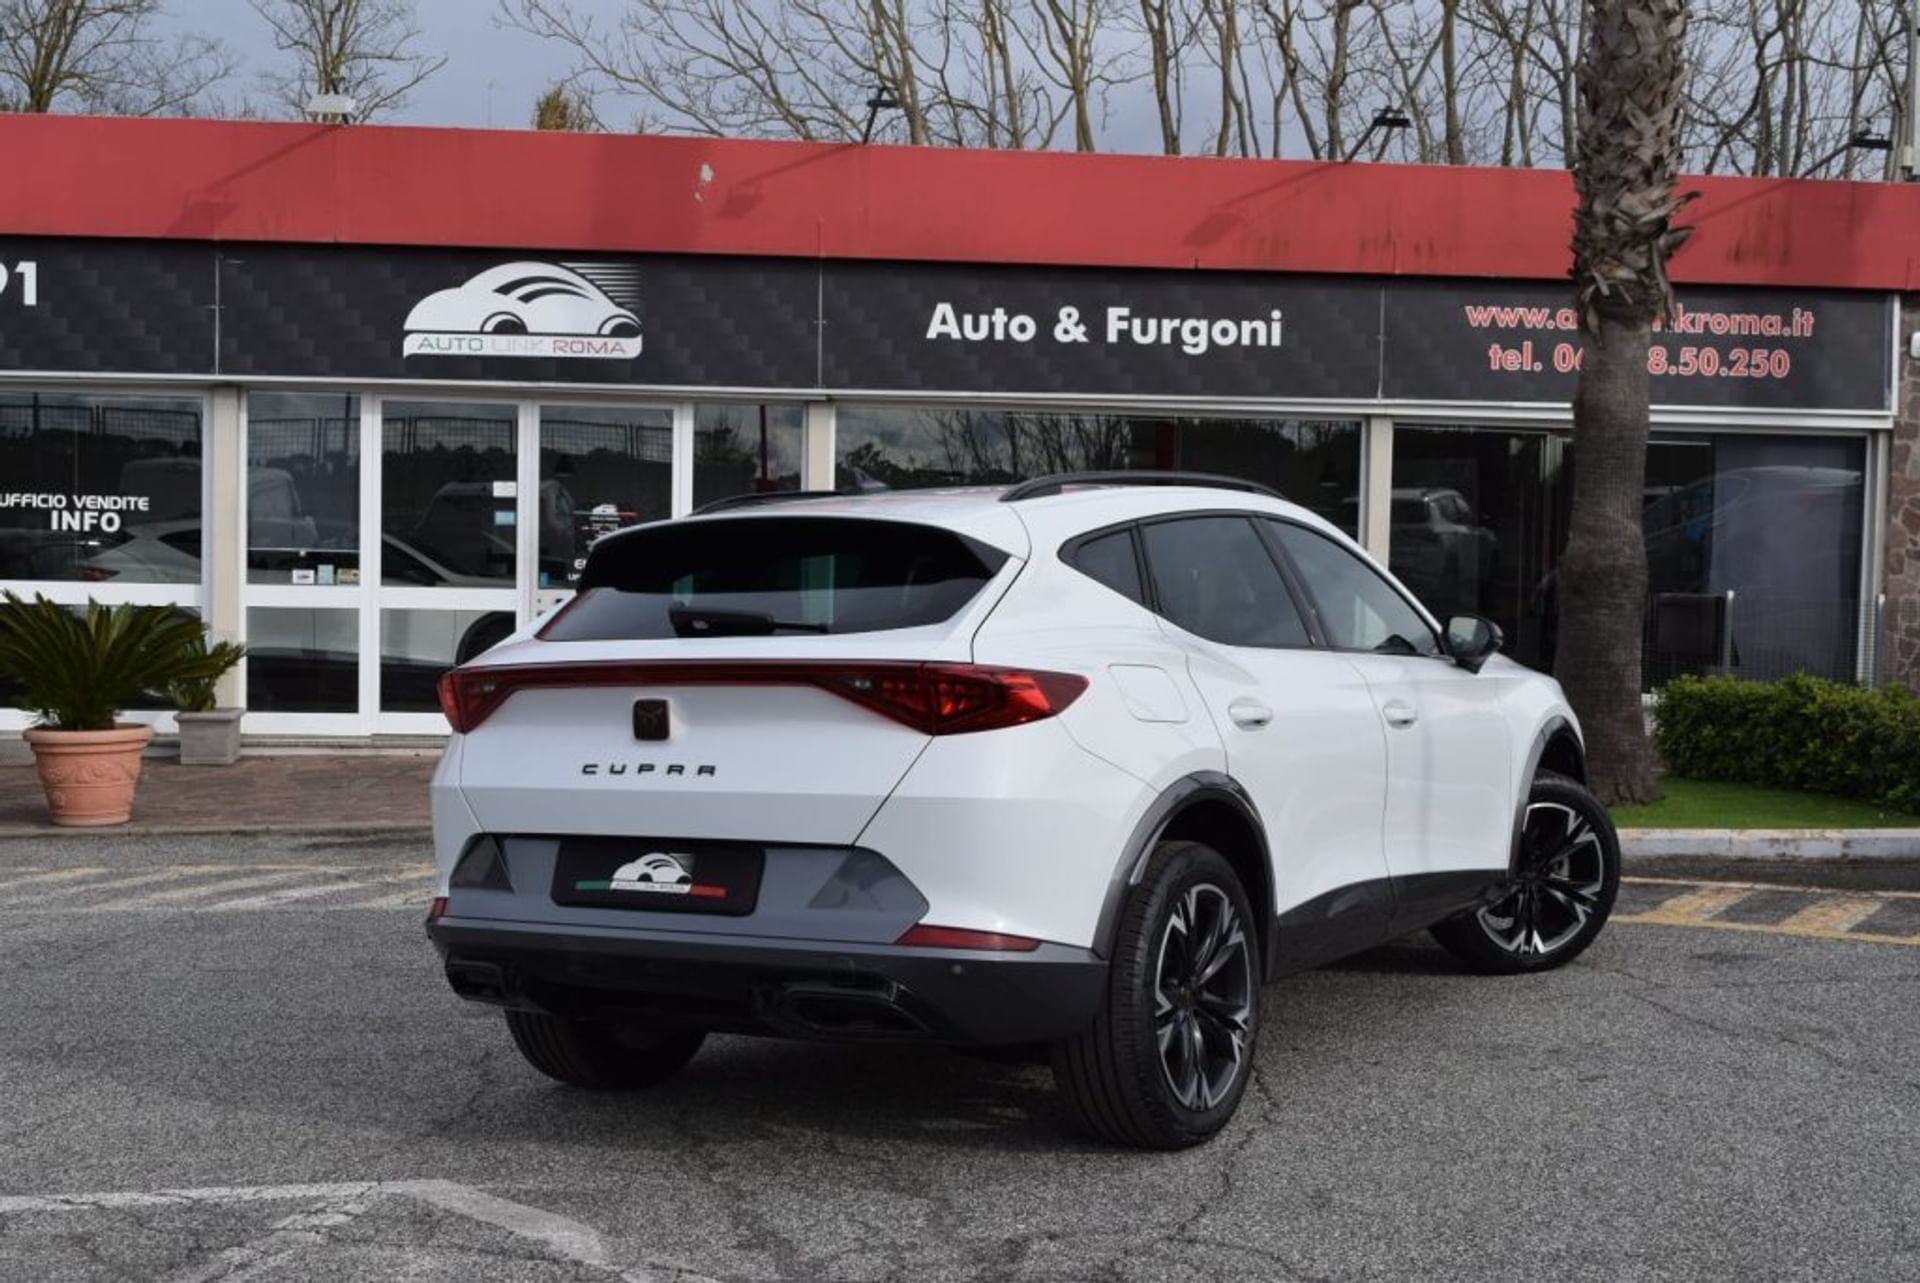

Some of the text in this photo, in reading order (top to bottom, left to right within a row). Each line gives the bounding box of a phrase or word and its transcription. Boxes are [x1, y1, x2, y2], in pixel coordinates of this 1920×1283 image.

[926, 302, 1282, 355] Auto & Furgoni
[417, 337, 626, 355] AUTO LINK ROMA
[1489, 340, 1543, 372] tel.
[0, 493, 150, 511] UFFICIO VENDITE
[51, 510, 121, 533] INFO
[581, 762, 717, 777] CUPRA
